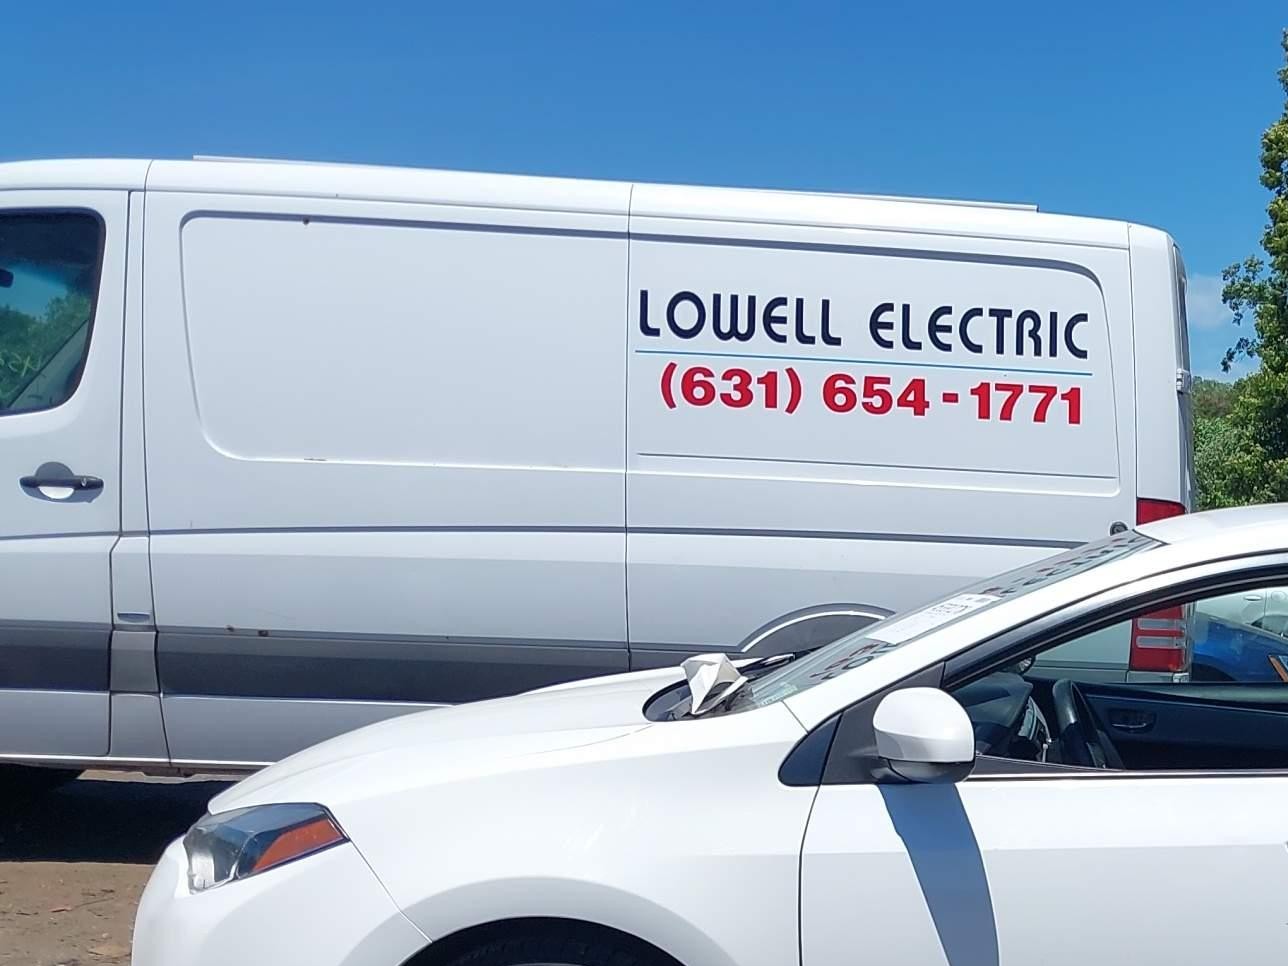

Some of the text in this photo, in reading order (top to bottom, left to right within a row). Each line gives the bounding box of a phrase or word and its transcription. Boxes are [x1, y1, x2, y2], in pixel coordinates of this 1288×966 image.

[639, 289, 1089, 360] LOWELL ELECTRIC
[660, 362, 802, 415] (631)
